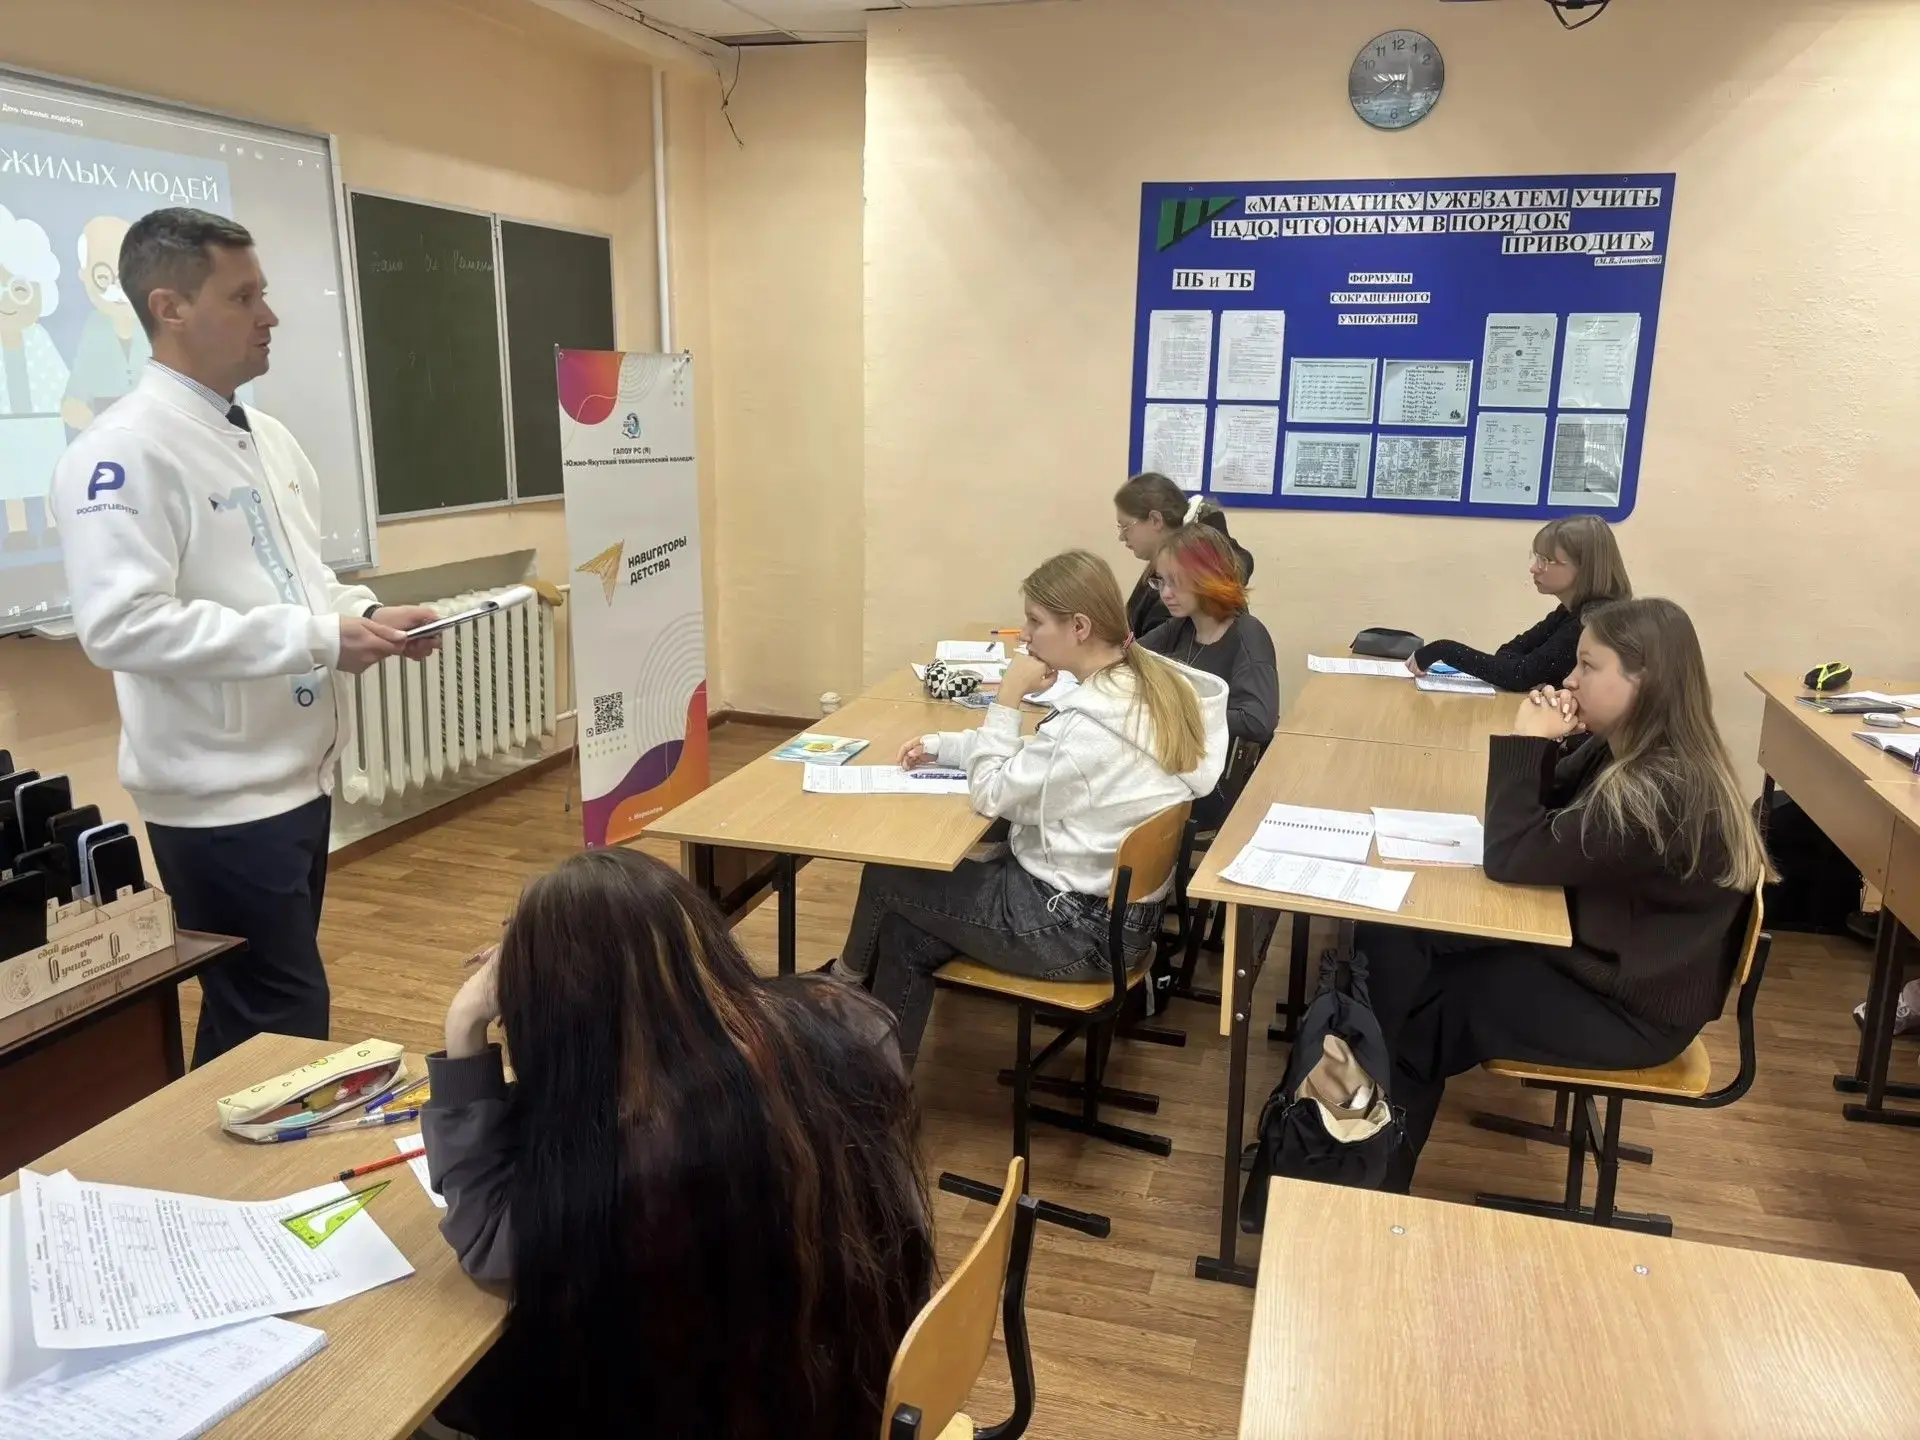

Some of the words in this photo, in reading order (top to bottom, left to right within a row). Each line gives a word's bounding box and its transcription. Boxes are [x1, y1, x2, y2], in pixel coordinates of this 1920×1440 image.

[1376, 46, 1386, 56] 11
[1392, 39, 1405, 50] 12
[1412, 43, 1418, 53] 1
[1363, 60, 1375, 70] 10
[1422, 54, 1431, 65] 2
[0, 148, 118, 189] ЖИЛЫХ
[126, 169, 219, 204] ЛЮДЕЙ
[1247, 192, 1423, 213] «МАТЕМАТИКУ
[1429, 191, 1482, 209] УЖЕ
[1484, 190, 1566, 208] ЗАТЕМ
[1576, 189, 1660, 207] УЧИТЬ
[1285, 218, 1330, 235] ЧТО
[1336, 217, 1385, 234] ОНА
[1391, 216, 1424, 233] УМ
[1432, 215, 1446, 232] В
[1452, 211, 1569, 232] ПОРЯДОК
[1504, 233, 1652, 253] ПРИВОДИТ»
[1176, 272, 1204, 287] ПБ
[1209, 276, 1220, 288] и
[1226, 272, 1252, 288] ТБ
[1349, 274, 1411, 283] ФОРМУЛЫ
[1331, 293, 1430, 303] СОКРАЩЕННОГО
[1340, 315, 1417, 324] УМНОЖЕНИЯ
[76, 503, 139, 515] РОСДЕТЦЕНТР
[628, 536, 687, 568] НАВИГАТОРЫ
[630, 558, 671, 585] ДЕТСТВА
[37, 944, 60, 960] сдай
[61, 933, 104, 955] телефон
[80, 950, 87, 958] и
[61, 958, 93, 977] учись
[82, 953, 130, 979] спокойно
